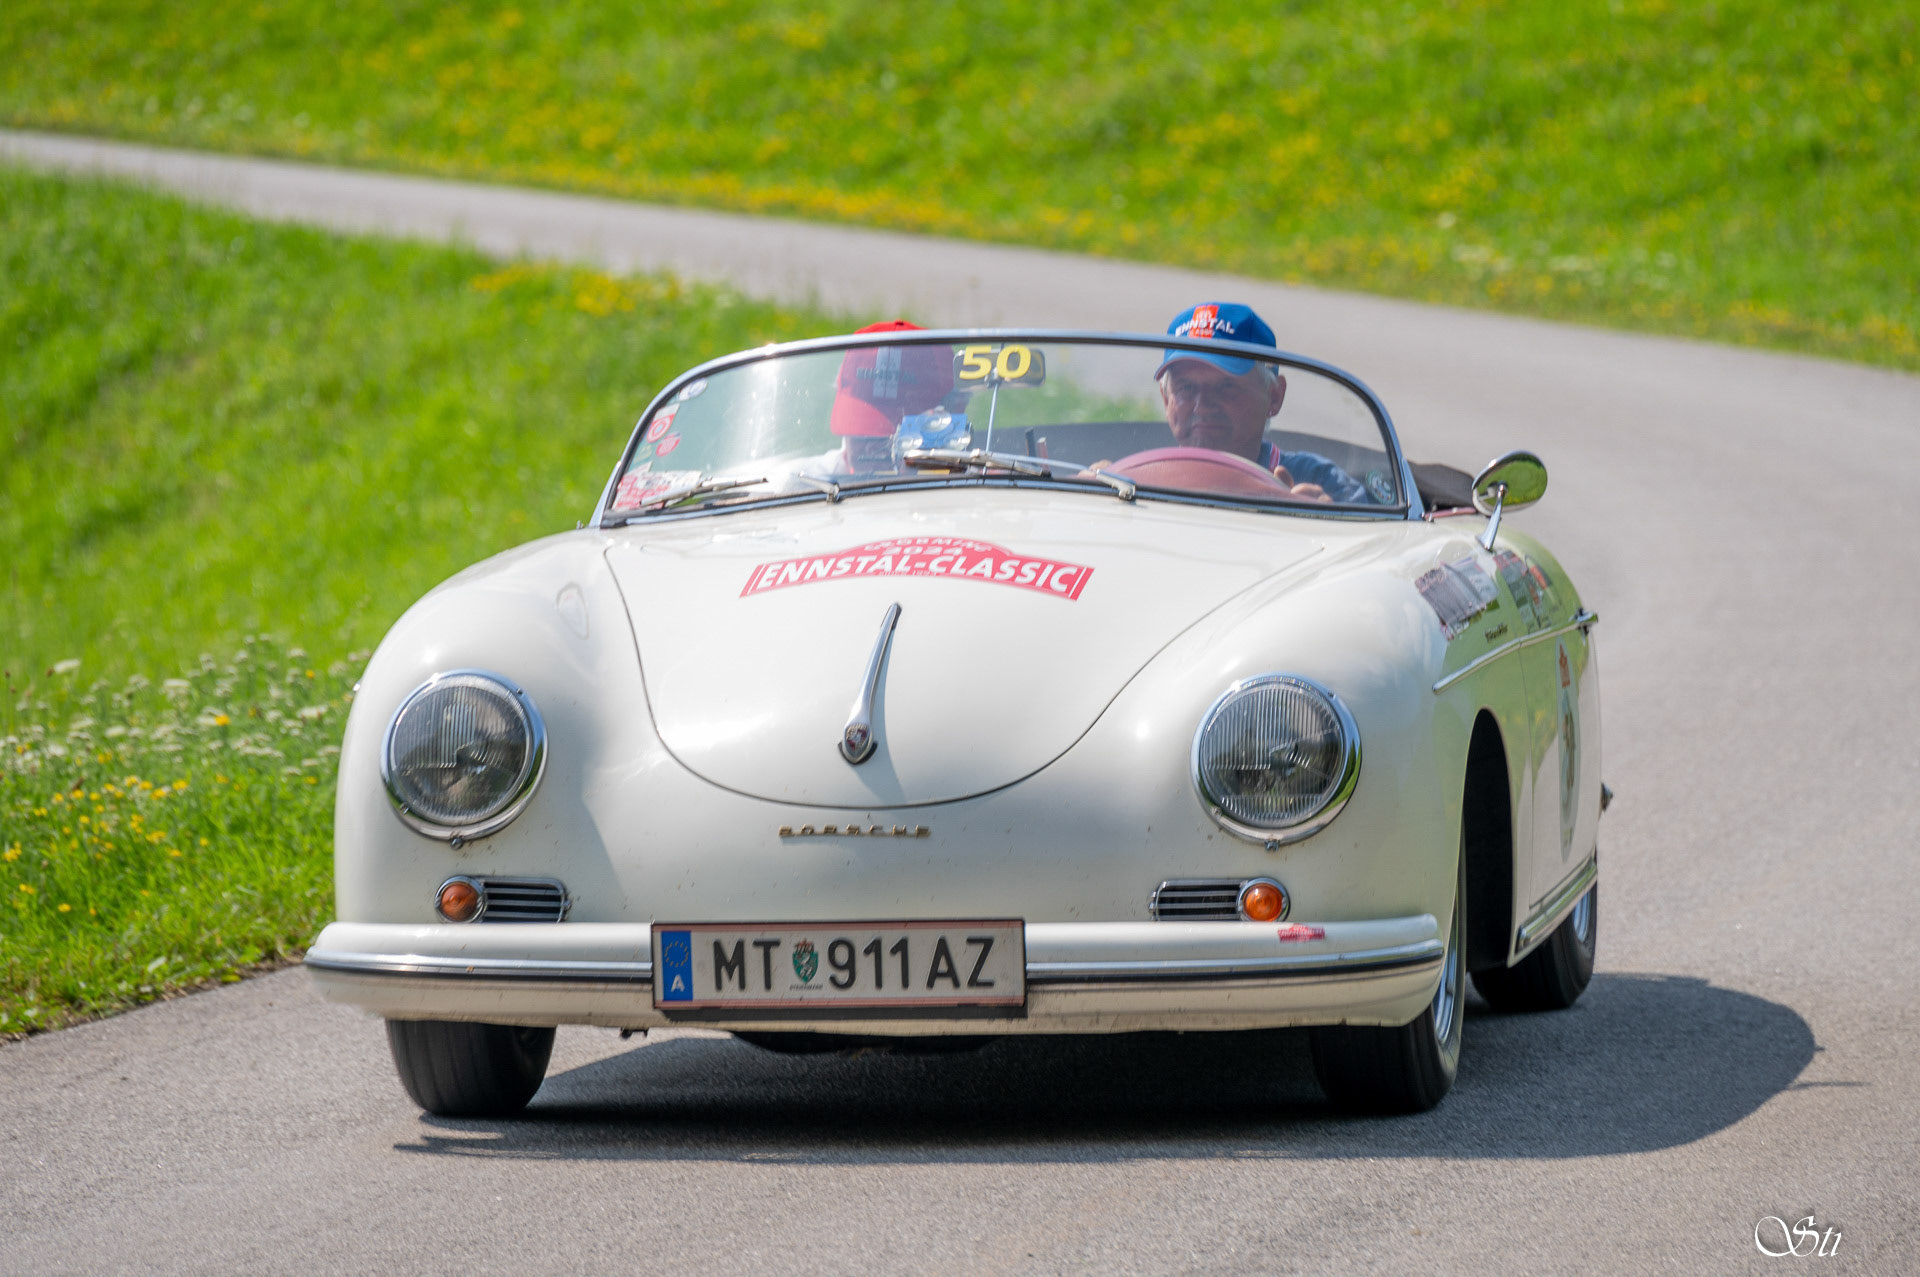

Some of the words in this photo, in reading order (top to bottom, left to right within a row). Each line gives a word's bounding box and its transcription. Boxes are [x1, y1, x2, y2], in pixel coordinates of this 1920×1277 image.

[1175, 318, 1236, 338] ENNSTAL
[959, 344, 1031, 379] 50
[882, 546, 963, 557] 2024
[756, 555, 1078, 593] ENNSTAL-CLASSIC
[778, 823, 932, 838] PORSCHE
[712, 937, 781, 992] MT
[827, 936, 910, 991] 911
[926, 936, 996, 989] AZ
[670, 974, 686, 993] A
